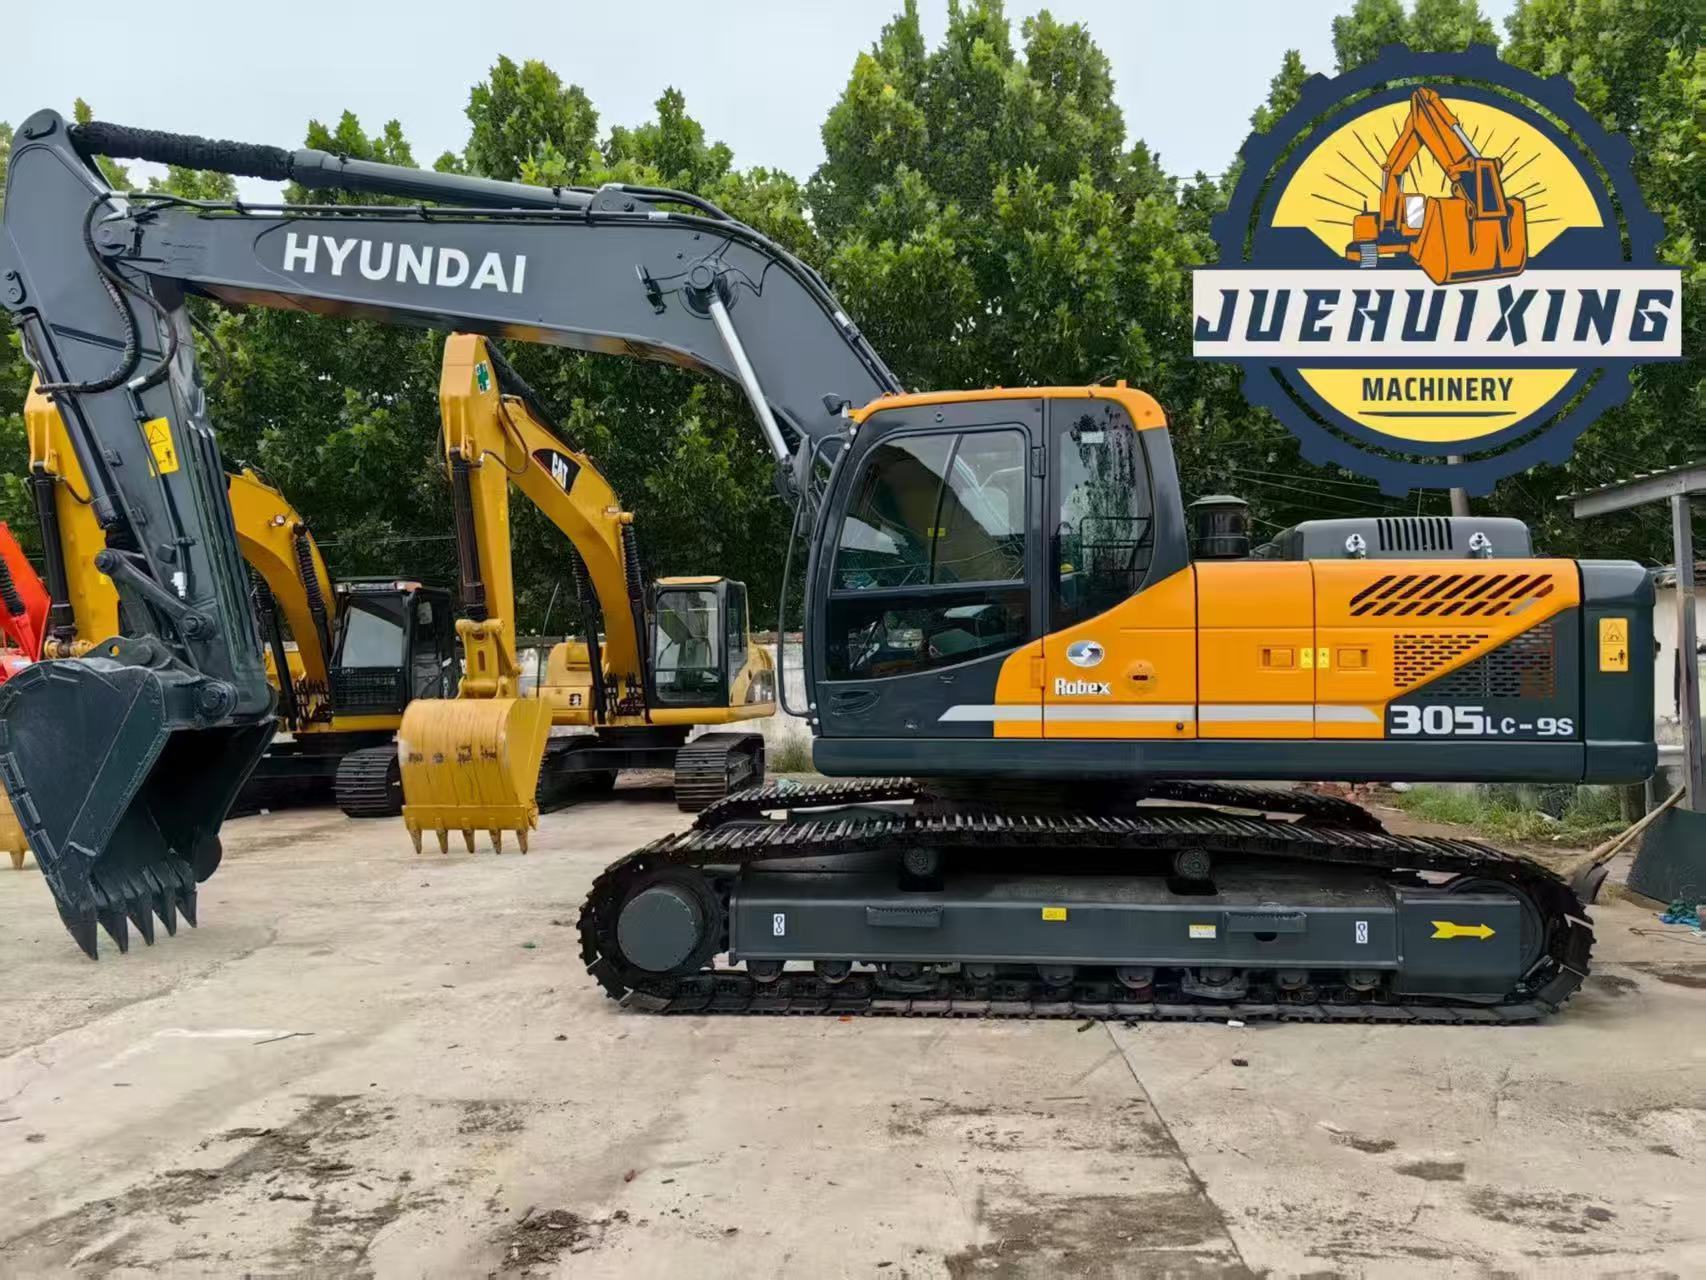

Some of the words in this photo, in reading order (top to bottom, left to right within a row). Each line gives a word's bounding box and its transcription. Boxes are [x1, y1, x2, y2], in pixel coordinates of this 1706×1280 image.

[283, 232, 527, 294] HYUNDAI
[551, 451, 569, 490] CAT
[1054, 677, 1112, 695] Robex
